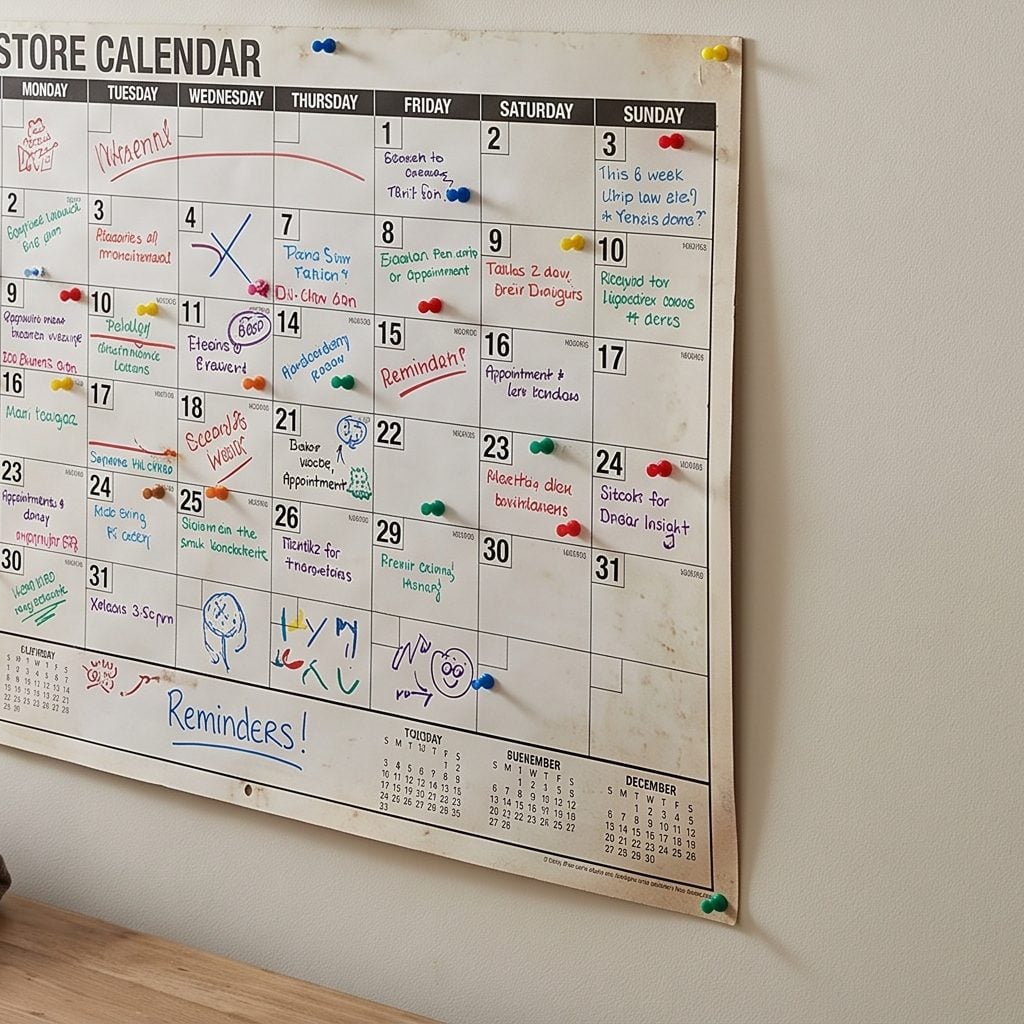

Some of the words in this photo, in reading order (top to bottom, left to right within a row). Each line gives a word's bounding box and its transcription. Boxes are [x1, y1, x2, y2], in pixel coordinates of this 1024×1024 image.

[96, 35, 261, 78] CALENDAR
[22, 82, 68, 97] MONDAY
[108, 85, 158, 101] TUESDAY
[189, 88, 263, 106] WEDNESDAY
[292, 92, 358, 110] THURSDAY
[404, 97, 451, 114] FRIDAY
[500, 101, 574, 119] SATURDAY
[624, 106, 685, 124] SUNDAY
[382, 121, 390, 144] 1
[488, 127, 500, 150] 2
[603, 132, 617, 157] 3
[599, 166, 629, 181] This
[648, 168, 684, 181] week
[7, 192, 17, 212] 2
[94, 200, 104, 220] 3
[185, 206, 196, 228] 4
[281, 213, 293, 235] 7
[382, 221, 394, 243] 8
[489, 228, 502, 252] 9
[598, 237, 624, 262] 10
[7, 282, 17, 303] 9
[91, 291, 111, 313] 10
[182, 301, 201, 323] 11
[277, 309, 299, 334] 14
[378, 320, 402, 345] 15
[485, 331, 510, 357] 16
[598, 344, 624, 370] 17
[2, 371, 22, 393] 16
[91, 383, 111, 405] 17
[181, 395, 202, 418] 18
[276, 407, 297, 431] 21
[377, 420, 402, 445] 22
[483, 434, 509, 460] 23
[2, 460, 22, 482] 23
[596, 449, 623, 476] 24
[90, 474, 111, 497] 24
[283, 471, 347, 491] Appointment
[180, 488, 202, 512] 25
[649, 491, 670, 507] for
[275, 504, 298, 529] 26
[376, 519, 401, 544] 29
[2, 548, 22, 571] 30
[324, 542, 341, 559] for
[483, 537, 509, 563] 30
[89, 565, 108, 588] 31
[596, 555, 619, 582] 31
[626, 775, 677, 796] DECEMBER
[619, 824, 627, 834] 14
[632, 828, 641, 837] 15
[646, 831, 655, 840] 16
[659, 834, 668, 843] 17
[673, 837, 682, 846] 18
[660, 822, 669, 831] 10
[673, 825, 680, 834] 11
[687, 828, 695, 837] 12
[605, 833, 615, 842] 20
[618, 836, 627, 846] 21
[632, 839, 641, 848] 22
[645, 842, 655, 852] 23
[658, 845, 668, 855] 24
[672, 849, 682, 858] 25
[605, 845, 614, 853] 27
[645, 854, 655, 863] 30
